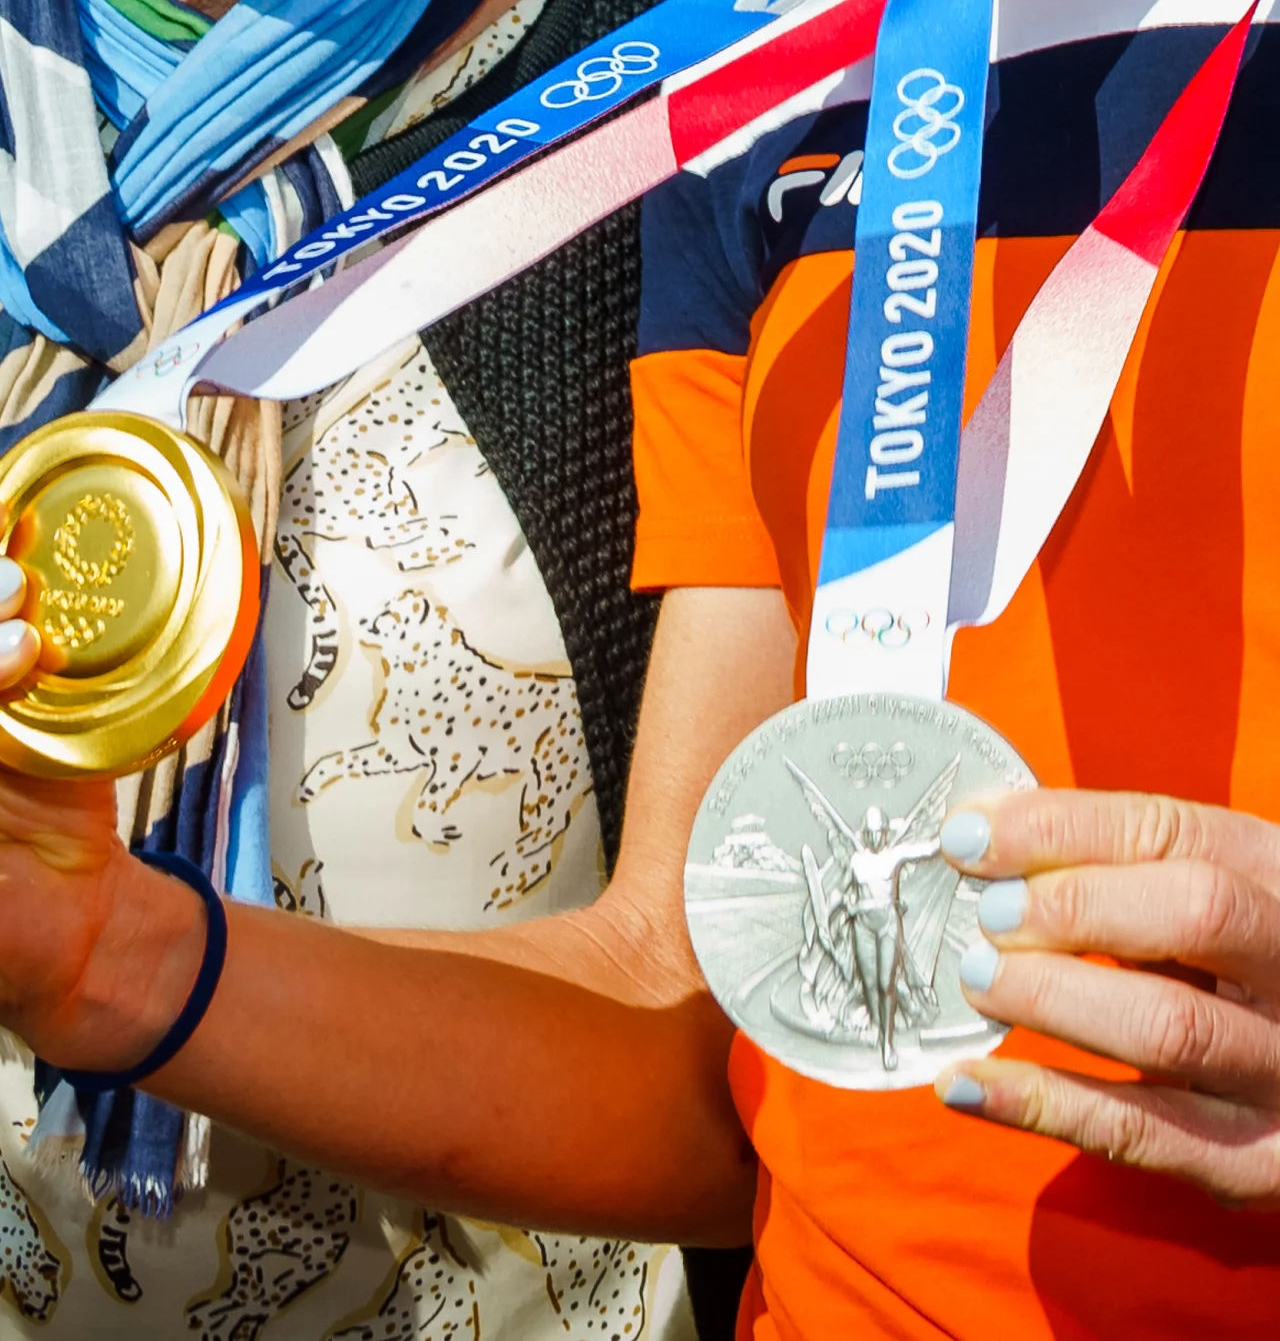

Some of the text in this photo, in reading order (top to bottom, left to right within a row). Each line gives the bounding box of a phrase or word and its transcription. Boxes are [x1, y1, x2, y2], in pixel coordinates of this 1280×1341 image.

[263, 117, 541, 281] TOKYO 2020
[864, 199, 944, 500] TOKYO 2020
[866, 693, 960, 736] Olympiad
